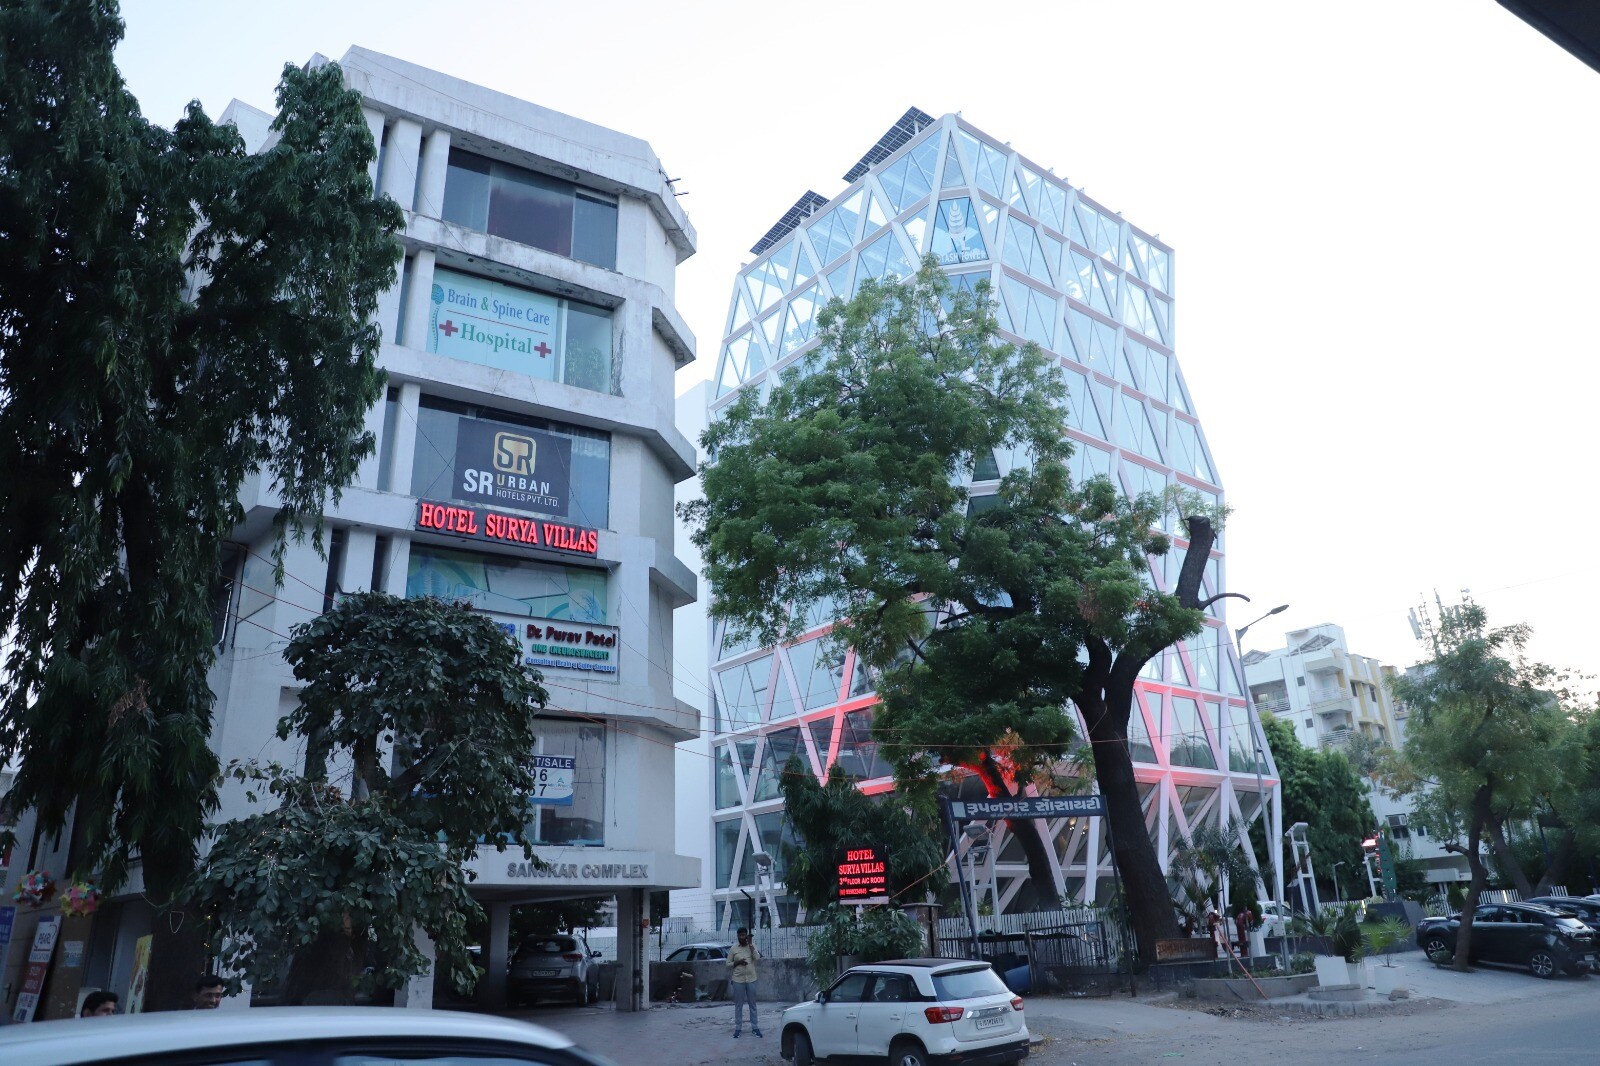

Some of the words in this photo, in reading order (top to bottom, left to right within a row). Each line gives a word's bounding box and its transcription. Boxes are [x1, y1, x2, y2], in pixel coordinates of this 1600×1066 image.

[447, 288, 477, 309] Brain
[480, 297, 489, 311] &
[492, 300, 523, 322] Spine
[526, 308, 550, 326] Care
[460, 322, 532, 355] Hospital
[463, 468, 493, 496] SR
[497, 477, 550, 495] URBAN
[496, 489, 526, 502] HOTELS
[526, 494, 543, 505] PVT.
[544, 497, 560, 508] LTD.
[420, 502, 478, 535] HOTEL
[485, 513, 539, 545] SURYA
[543, 523, 598, 554] VILLAS
[546, 626, 582, 644] Purav
[585, 631, 616, 647] Patel
[529, 757, 571, 768] T/SALE
[966, 801, 1030, 815] રૂપનગર
[847, 849, 874, 861] HOTEL
[581, 864, 649, 879] COMPLEX
[838, 863, 860, 875] SURYA
[860, 861, 885, 874] VILLAS
